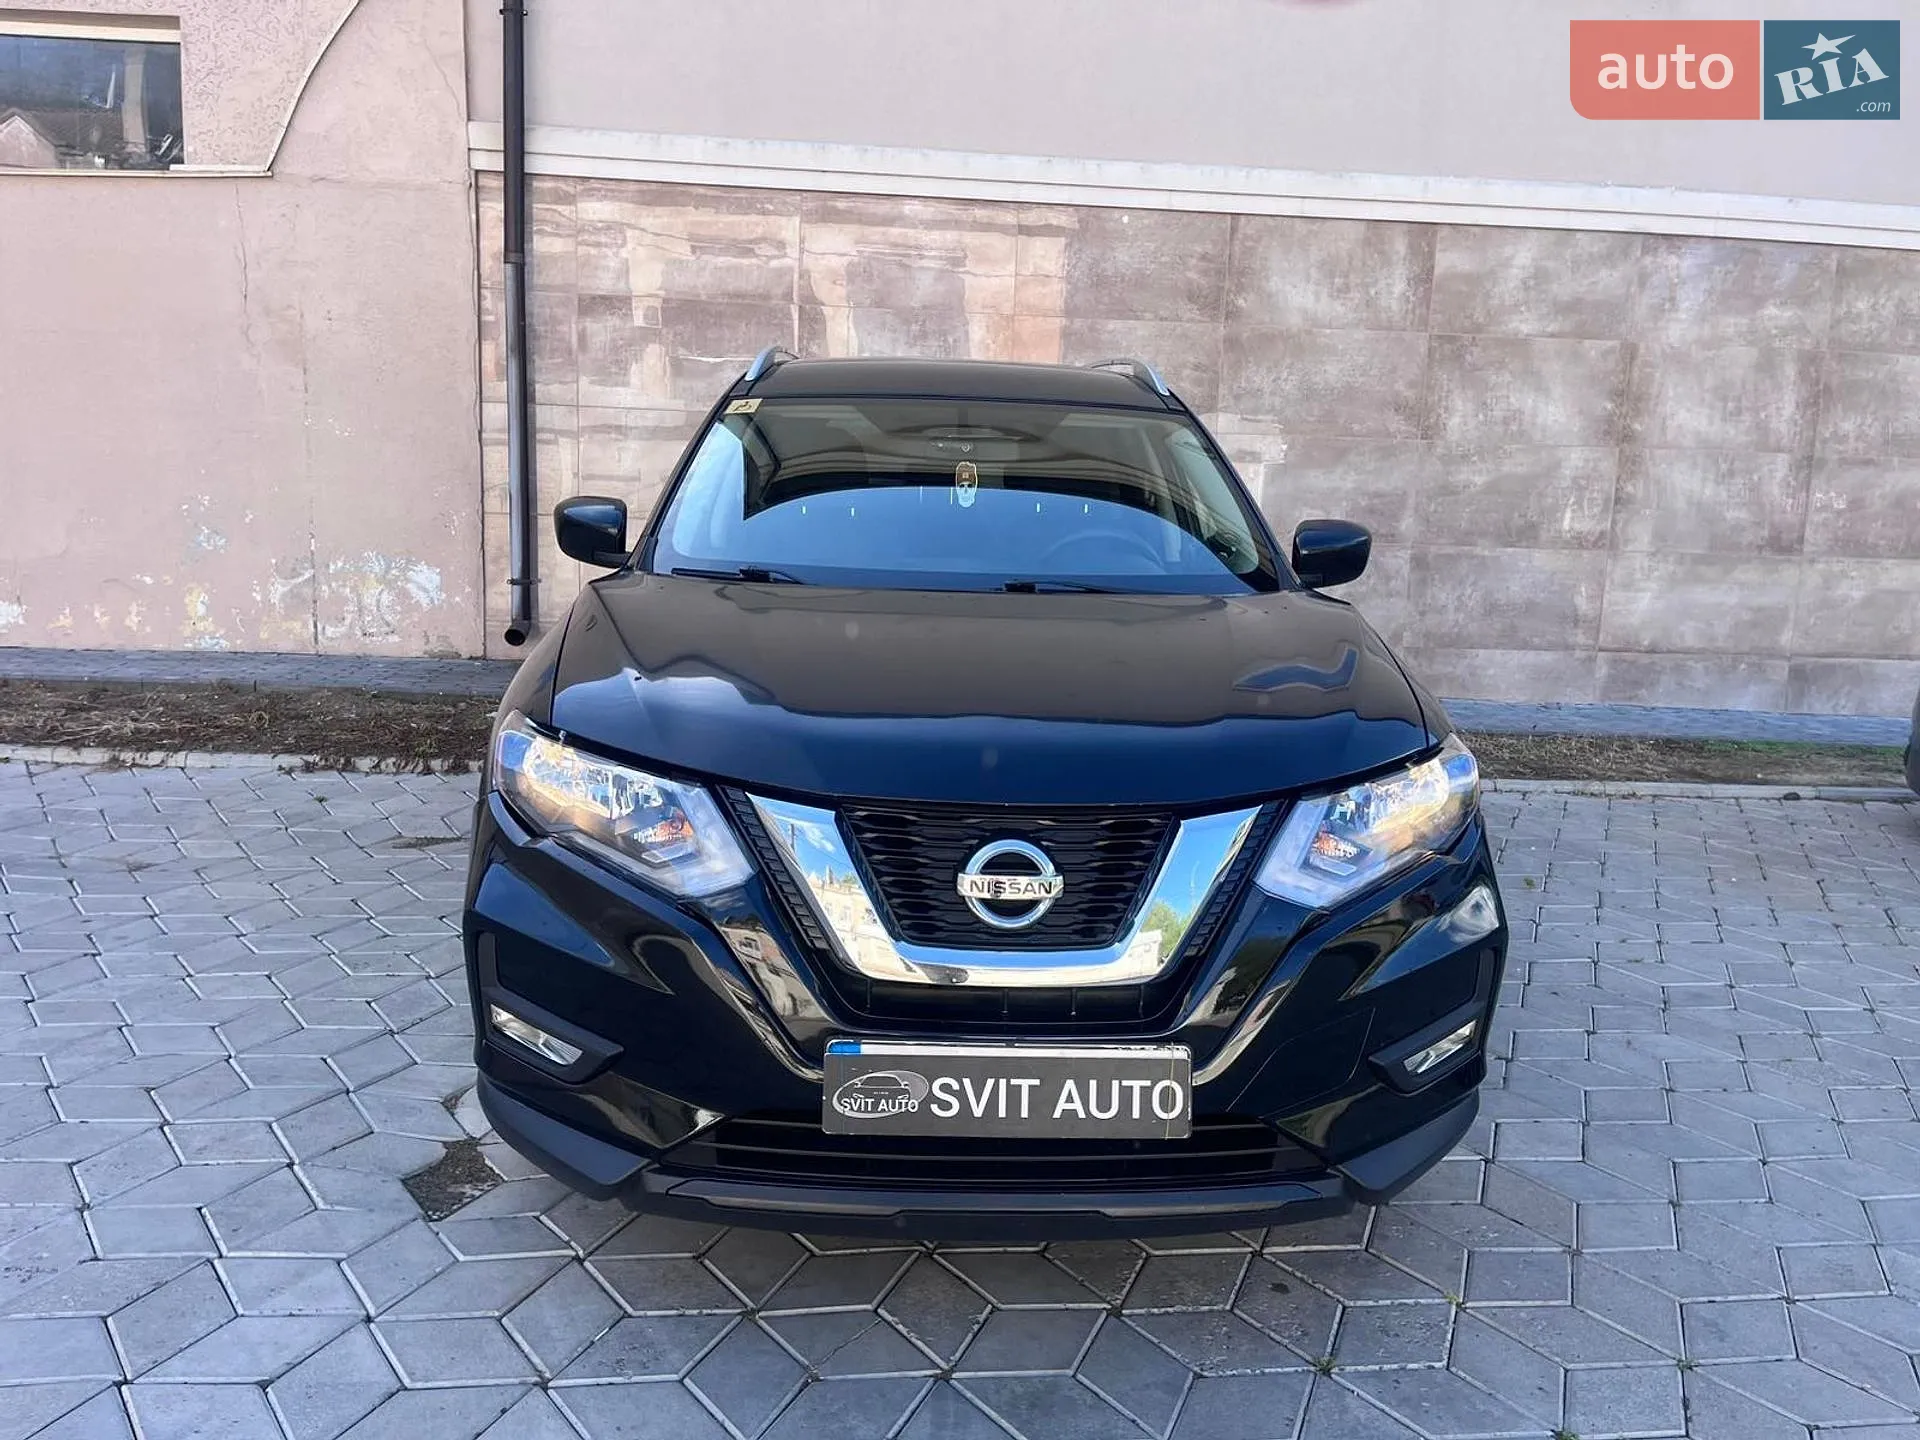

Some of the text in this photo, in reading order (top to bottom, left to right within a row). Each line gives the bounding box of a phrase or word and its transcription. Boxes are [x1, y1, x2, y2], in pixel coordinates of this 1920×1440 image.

[969, 879, 1052, 896] NISSAN
[841, 1098, 919, 1113] SVIT AUTO
[930, 1077, 1184, 1120] SVIT AUTO
